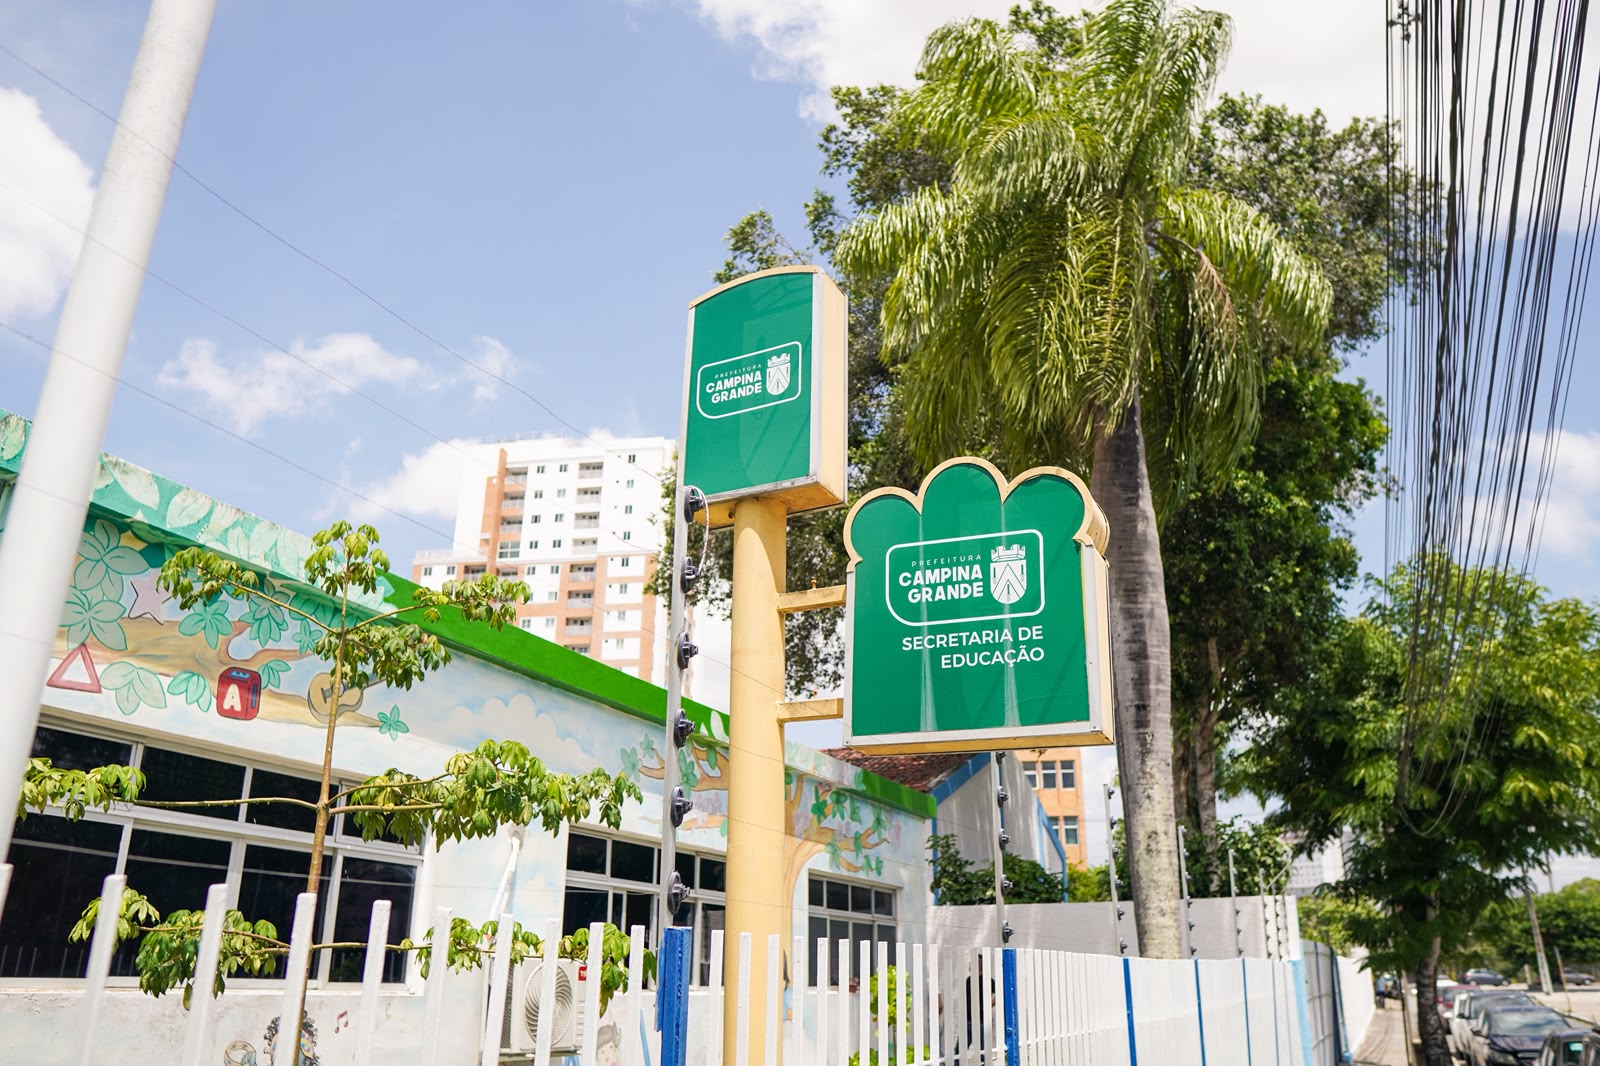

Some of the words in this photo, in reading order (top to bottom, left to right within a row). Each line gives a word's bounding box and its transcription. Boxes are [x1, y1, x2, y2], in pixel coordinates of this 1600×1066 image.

[706, 371, 762, 393] CAMPINA
[715, 364, 761, 379] PREFEITURA
[711, 382, 762, 403] GRANDE
[912, 554, 982, 567] PREFEITURA
[899, 564, 983, 587] CAMPINA
[908, 581, 984, 603] GRANDE
[902, 628, 1013, 651] SECRETARIA
[1018, 625, 1044, 641] DE
[941, 645, 1045, 668] EDUCAÇÃO
[223, 683, 242, 712] A
